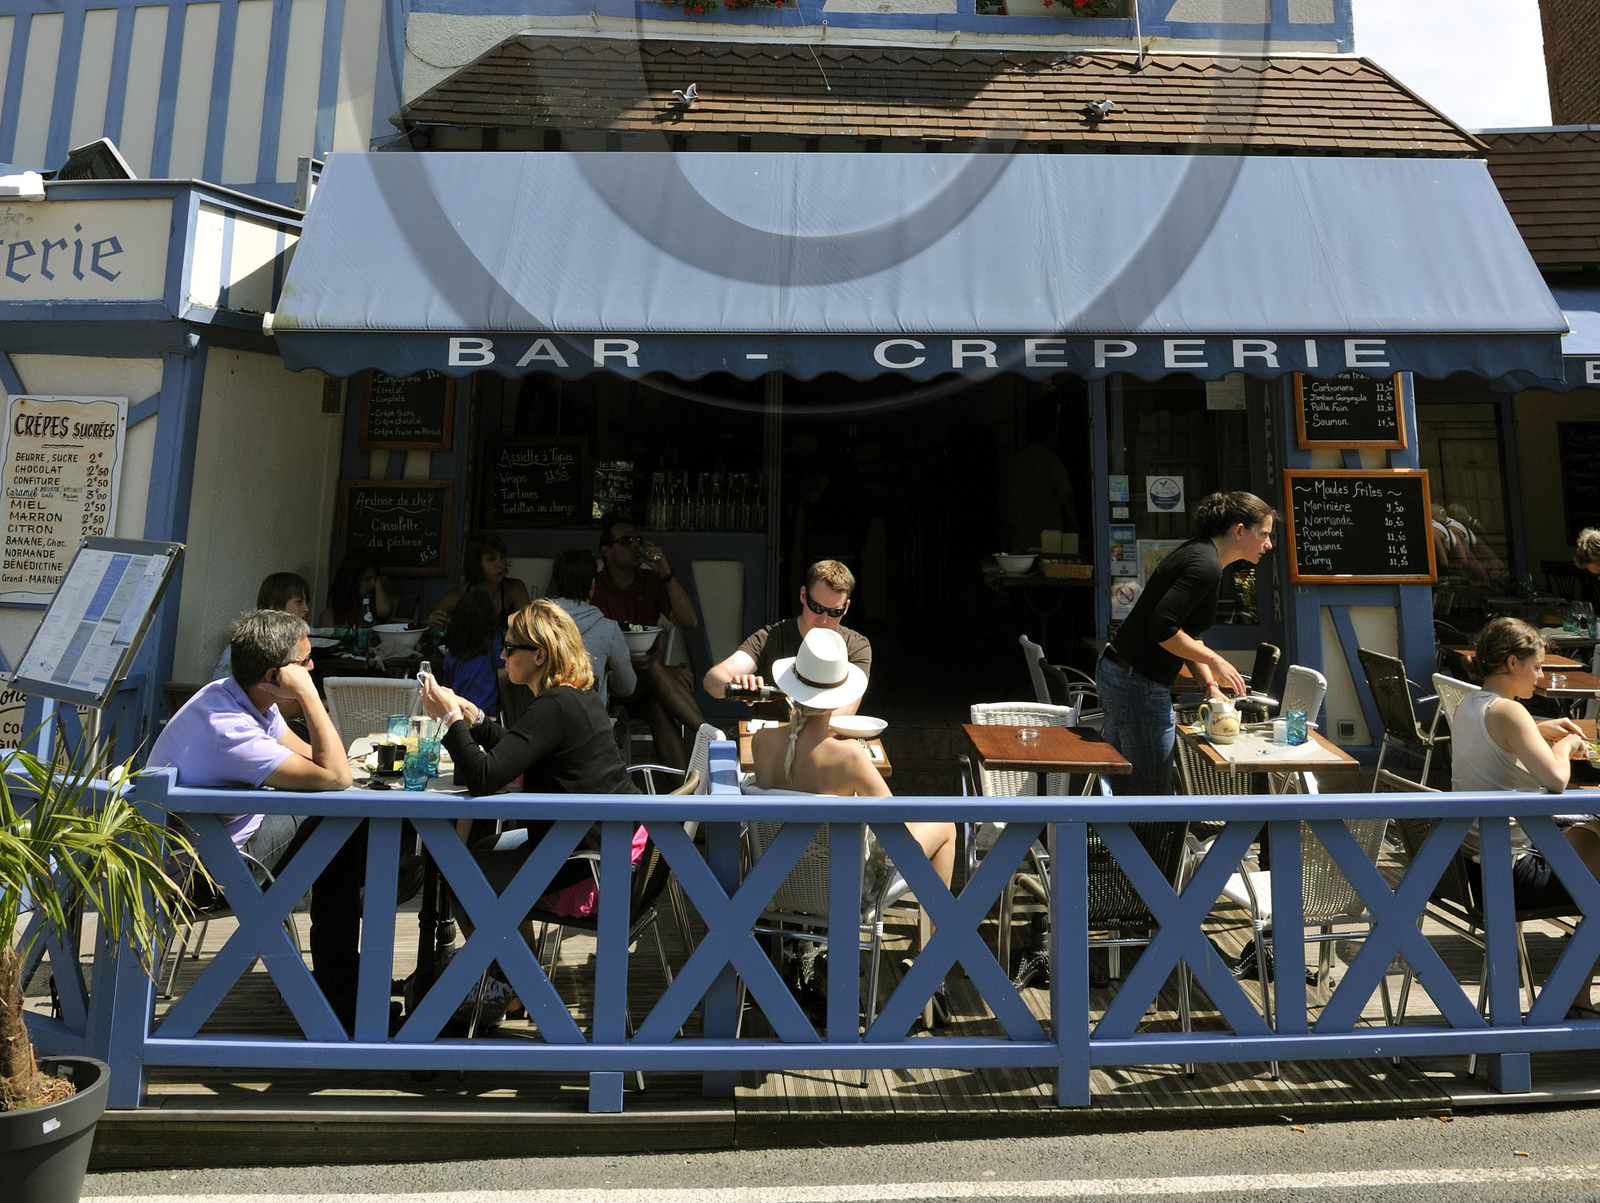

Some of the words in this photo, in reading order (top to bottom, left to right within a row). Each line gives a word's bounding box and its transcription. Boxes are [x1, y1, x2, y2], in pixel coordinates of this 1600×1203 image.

[447, 337, 640, 368] BAR
[873, 337, 1391, 369] CREPERIE
[52, 453, 79, 463] SUCRE
[15, 465, 64, 474] CHOCOLAT
[13, 476, 61, 486] CONFITURE
[498, 471, 527, 488] Wraps
[6, 487, 38, 498] Caramel
[500, 488, 539, 500] Tartines
[1314, 479, 1349, 499] Moules
[10, 500, 47, 510] MIEL
[356, 492, 394, 513] Ardoise
[412, 491, 434, 510] chef
[1303, 500, 1352, 514] Marinière
[9, 511, 63, 522] MARRON
[1304, 514, 1354, 527] Normande
[7, 524, 53, 534] CITRON
[1302, 526, 1344, 541] Roquefort
[367, 534, 383, 547] du
[4, 549, 56, 558] NORMANDE
[1303, 541, 1342, 556] Paysanne
[3, 559, 63, 571] BÉNÉDICTINE
[1305, 555, 1333, 571] Curry
